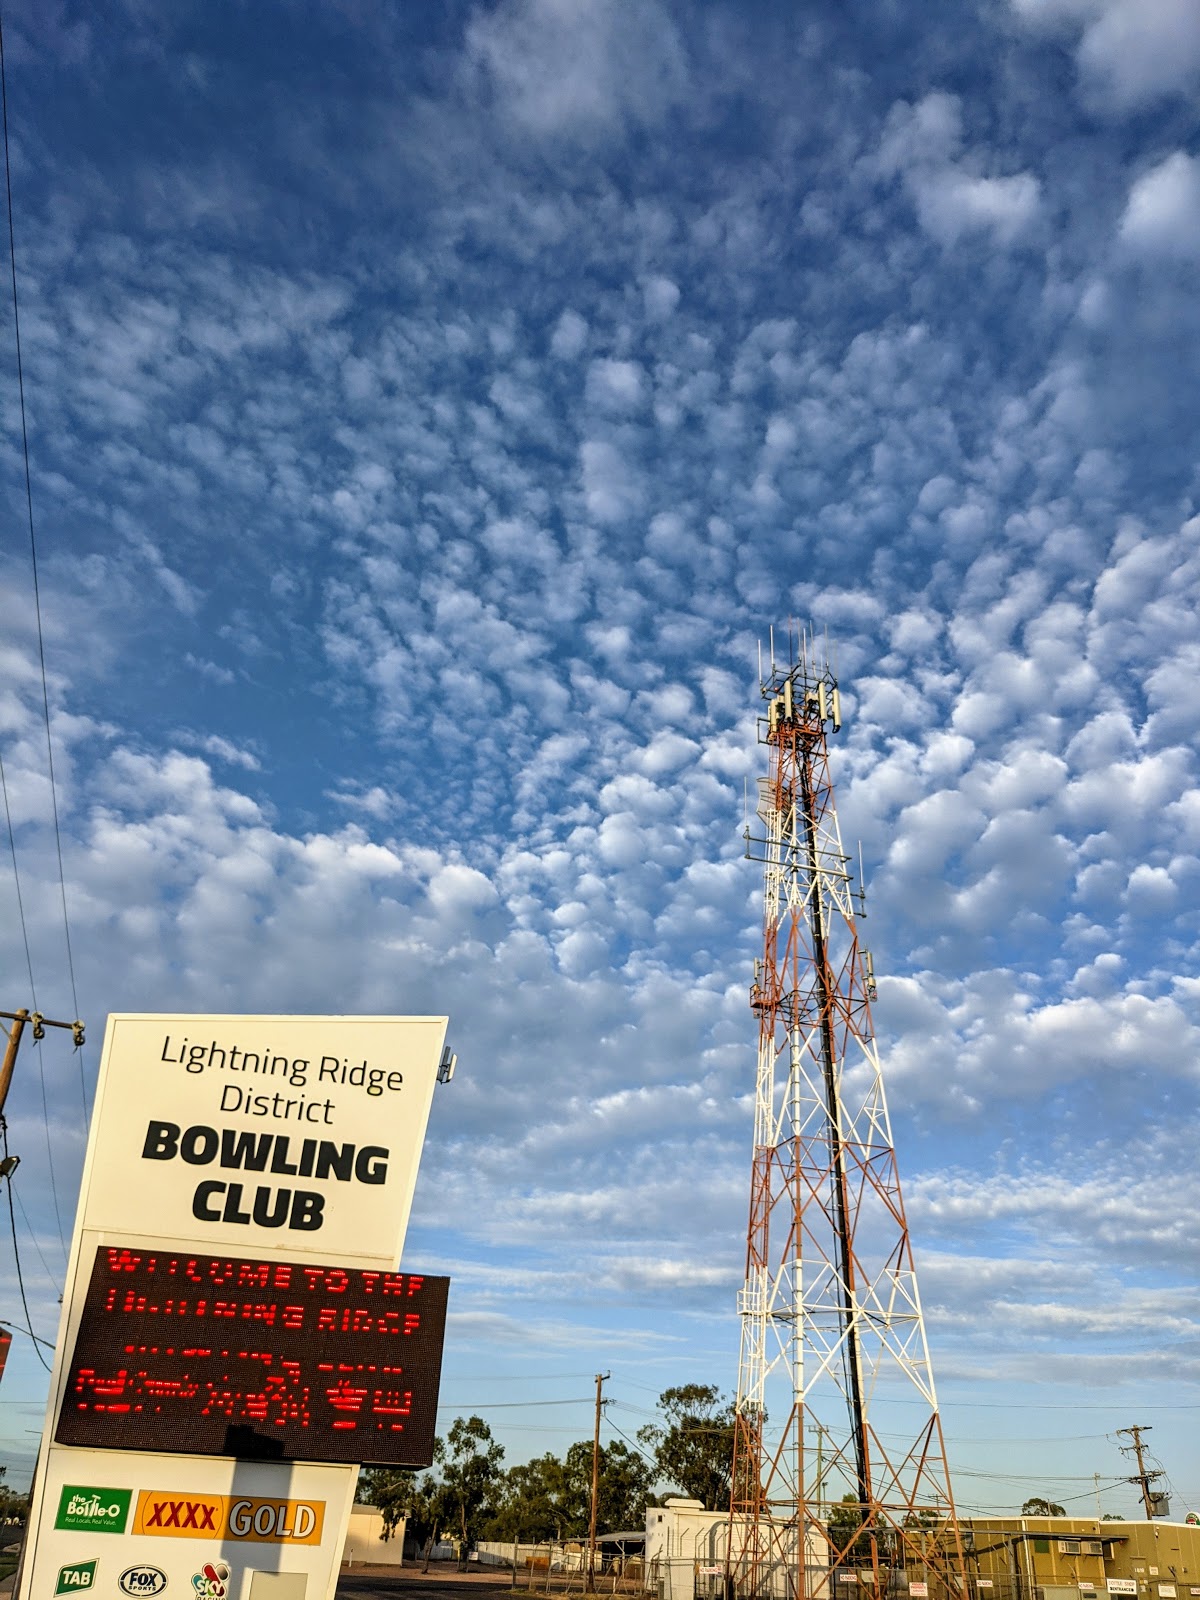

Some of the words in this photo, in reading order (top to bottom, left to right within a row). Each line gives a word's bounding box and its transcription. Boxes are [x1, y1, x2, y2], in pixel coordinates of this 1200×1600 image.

[160, 1035, 310, 1087] Lightning
[318, 1056, 403, 1096] Ridge
[219, 1084, 336, 1125] District
[141, 1120, 390, 1185] BOWLING
[192, 1180, 326, 1232] CLUB
[72, 1494, 86, 1503] the
[146, 1501, 216, 1531] XXXX
[228, 1500, 317, 1539] GOLD
[63, 1571, 91, 1586] TAB
[129, 1572, 158, 1587] FOX
[196, 1579, 224, 1595] SKY
